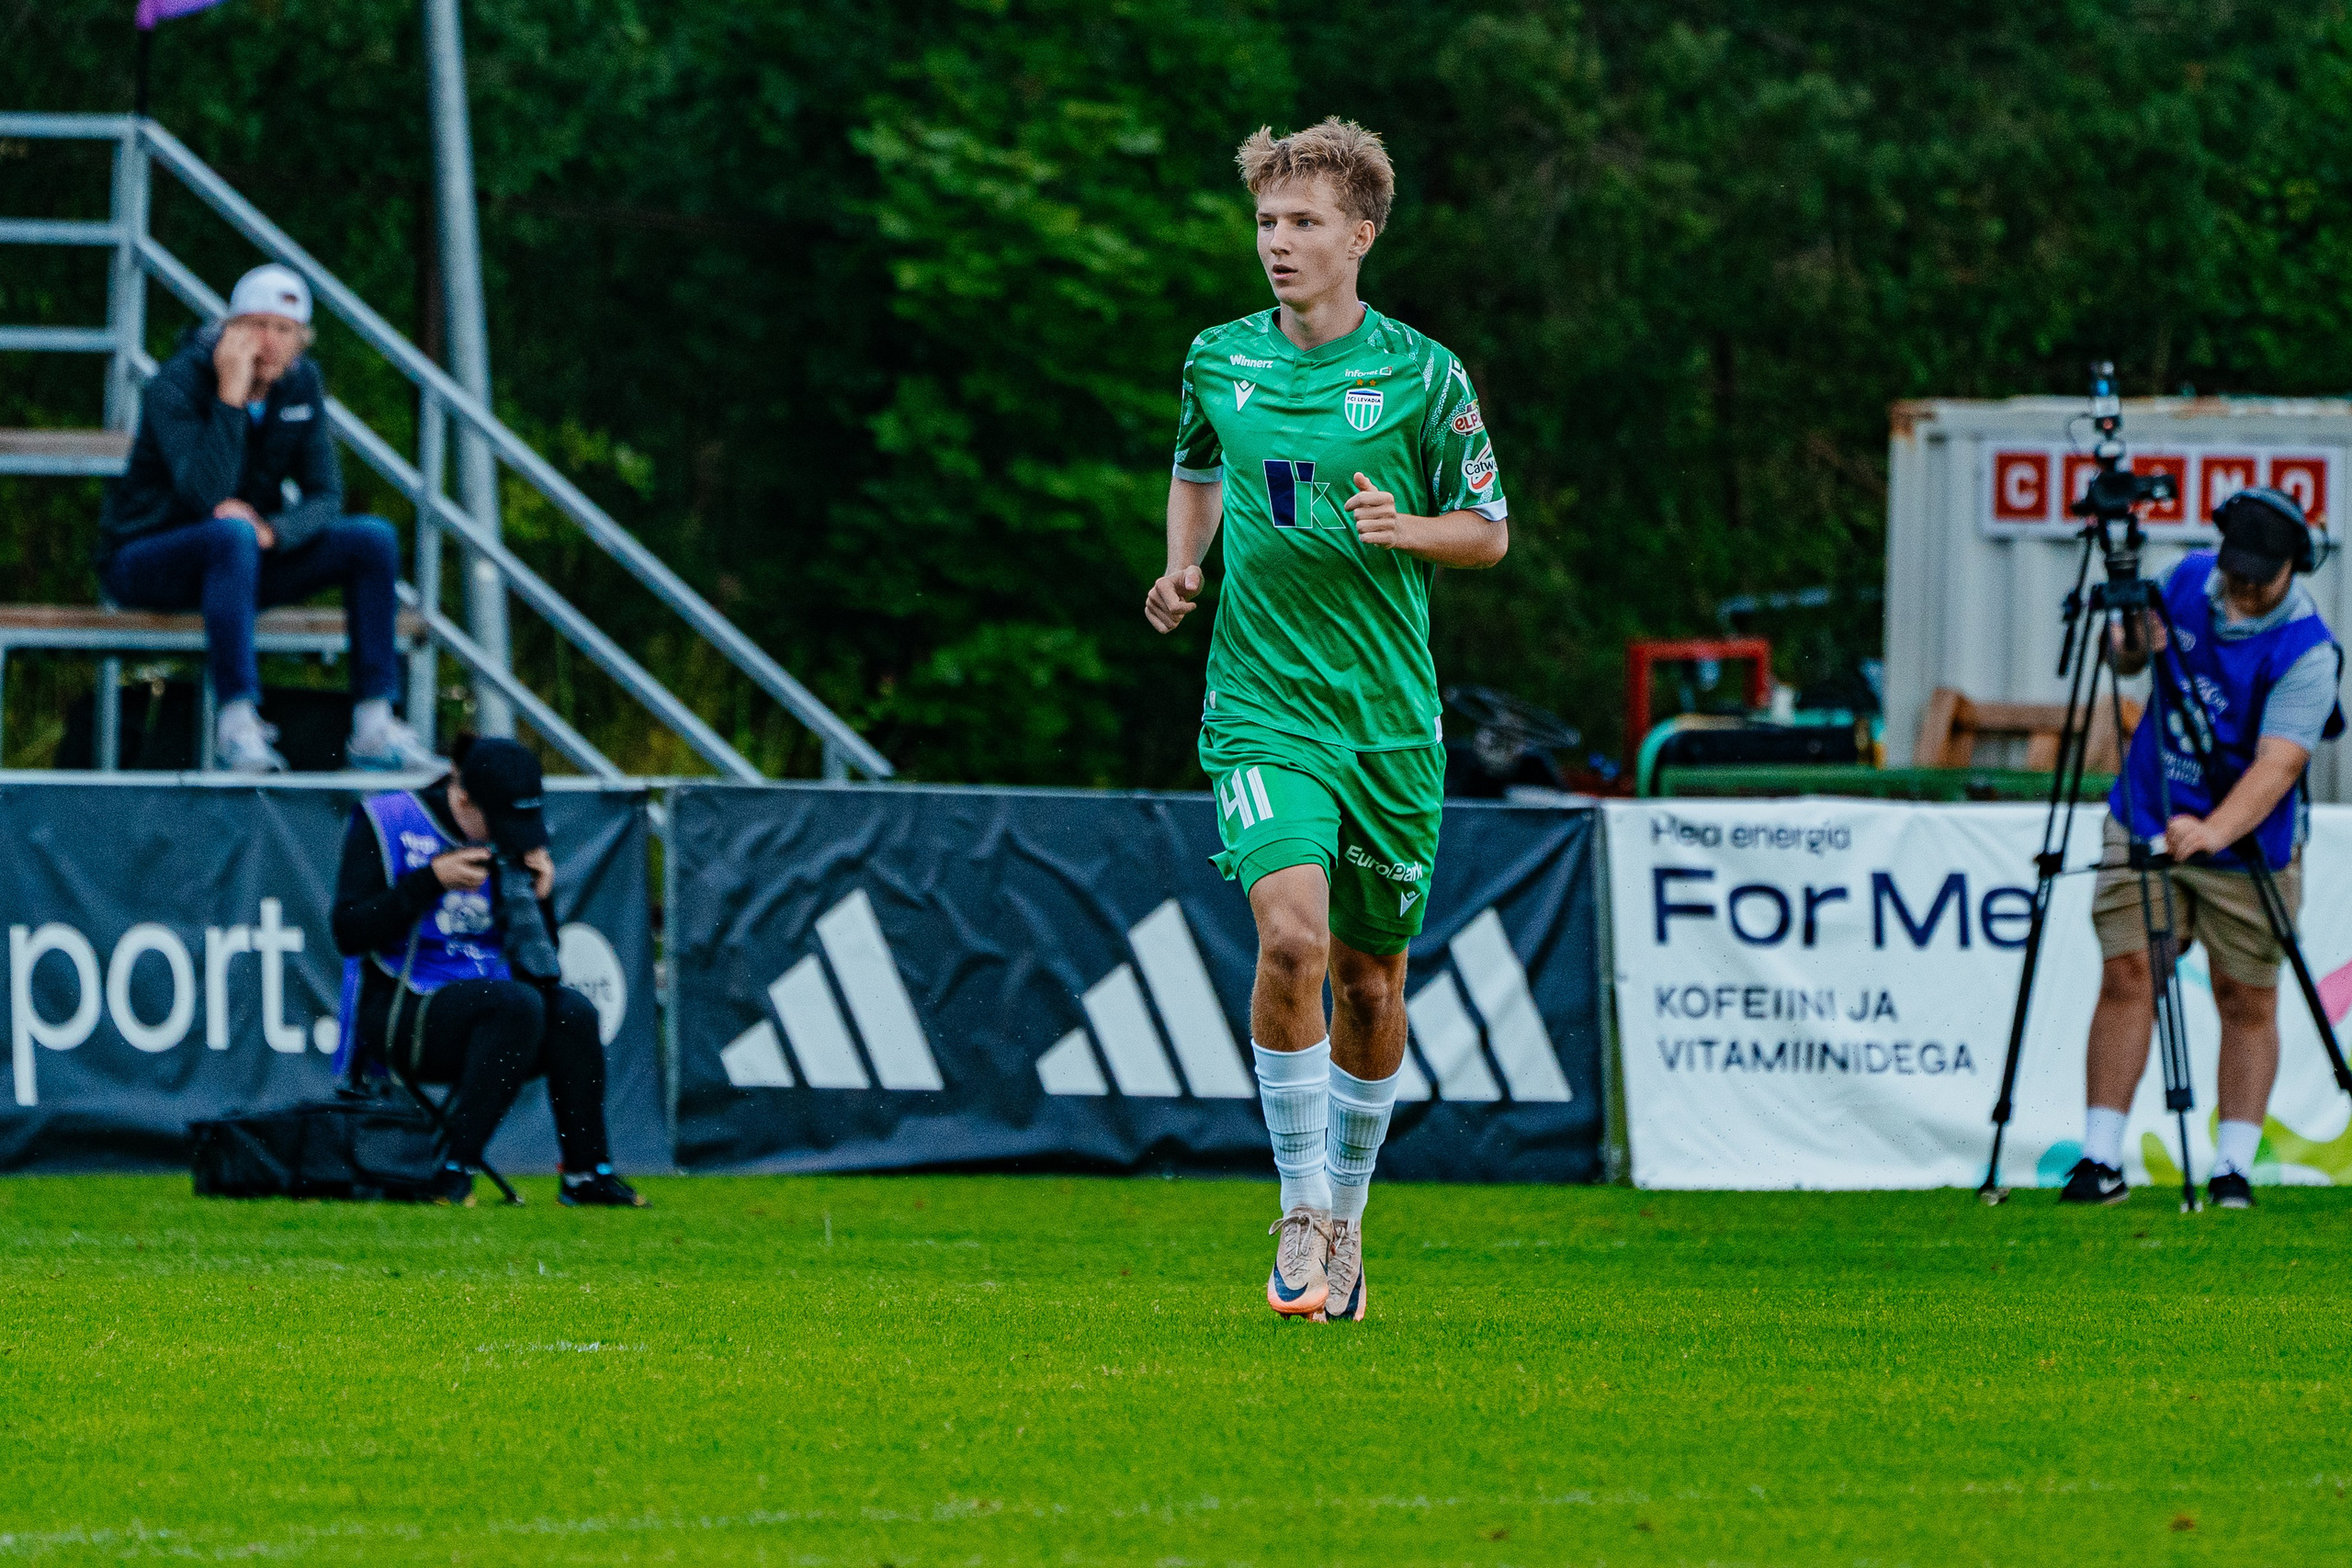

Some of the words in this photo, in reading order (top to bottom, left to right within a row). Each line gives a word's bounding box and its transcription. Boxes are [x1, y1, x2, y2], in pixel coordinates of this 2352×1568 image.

[1229, 354, 1273, 368] Winnerz
[1345, 368, 1378, 378] infonet
[1219, 765, 1274, 830] 41
[1730, 820, 1851, 858] energia
[1344, 844, 1423, 883] EuroPark
[1652, 866, 1849, 949] For
[1871, 870, 2041, 950] Me
[1655, 986, 1837, 1020] KOFEIINI
[1848, 990, 1898, 1022] JA
[1657, 1038, 1977, 1075] VITAMIINIDEGA
